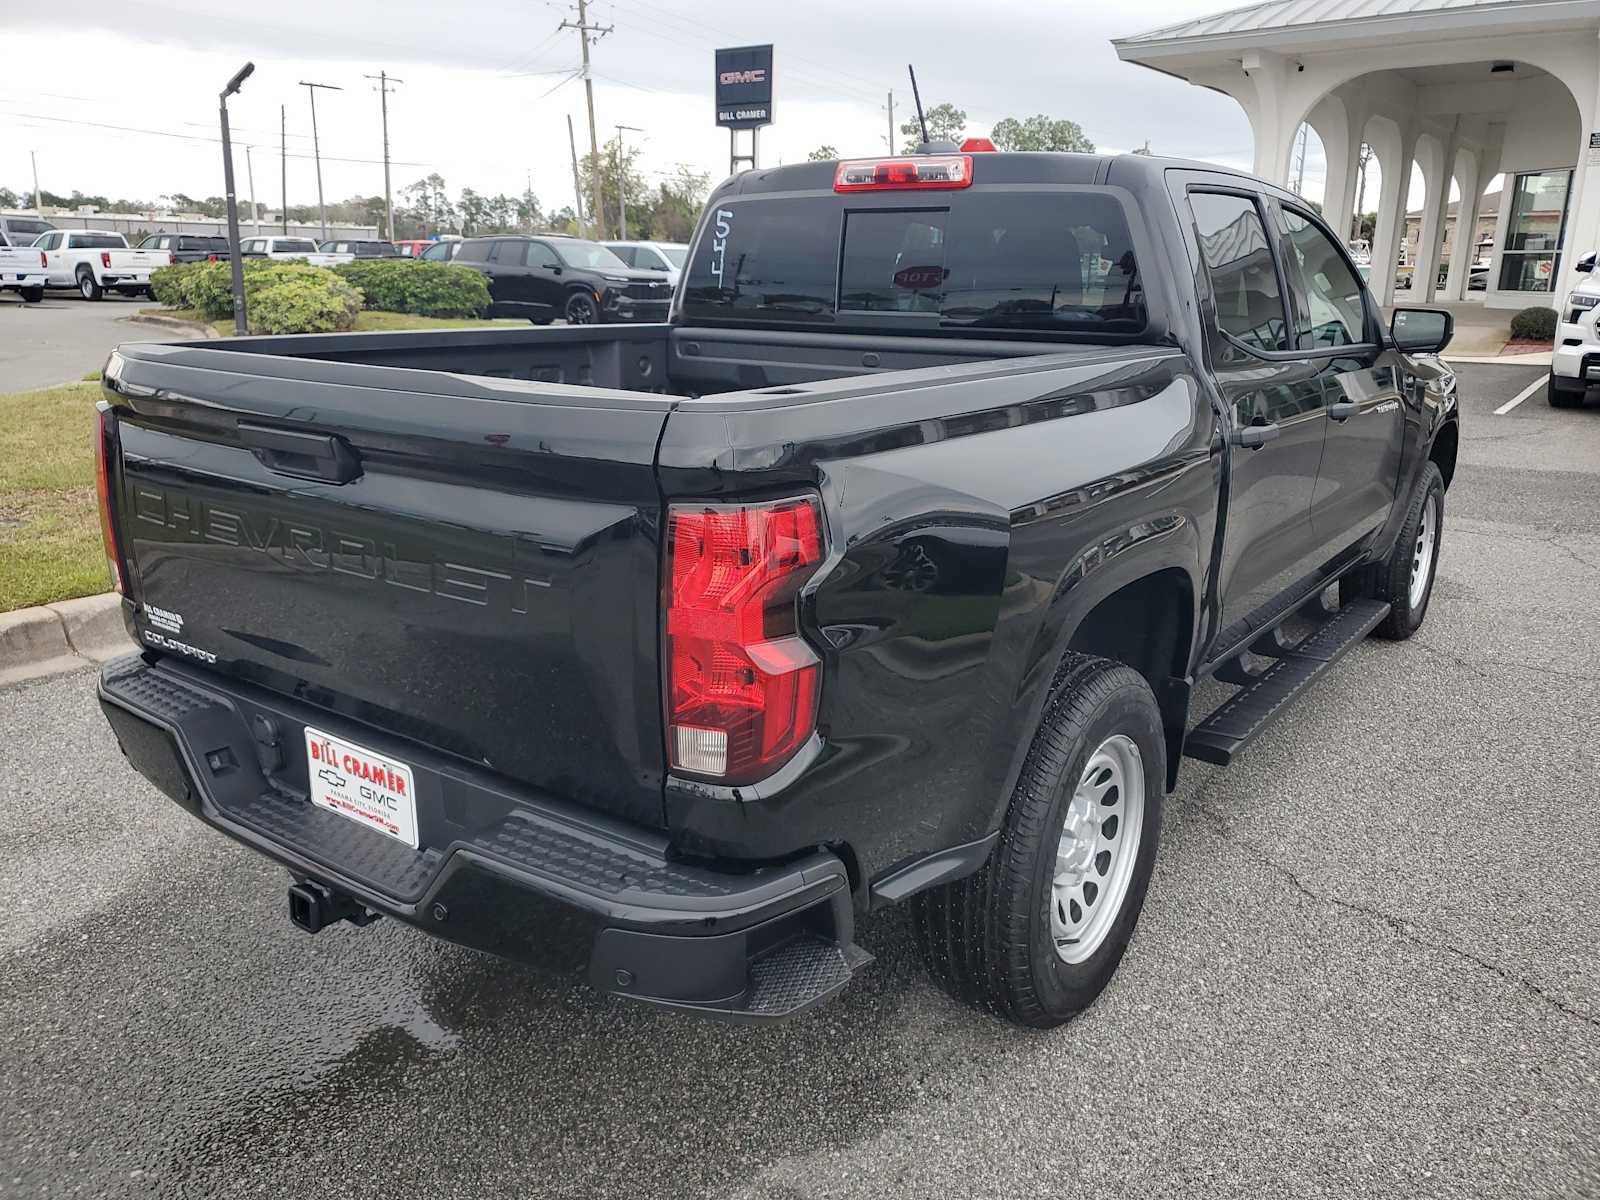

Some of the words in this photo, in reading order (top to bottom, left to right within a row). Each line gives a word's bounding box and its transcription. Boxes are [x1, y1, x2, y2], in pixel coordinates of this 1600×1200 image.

[720, 70, 765, 84] GMC
[719, 112, 735, 120] BILL
[736, 110, 766, 119] CRAMER
[134, 489, 553, 615] CHEVROLET
[145, 630, 217, 664] COLORADO
[310, 740, 339, 768] BILL
[343, 754, 407, 796] CRAMER
[360, 785, 398, 811] GMC
